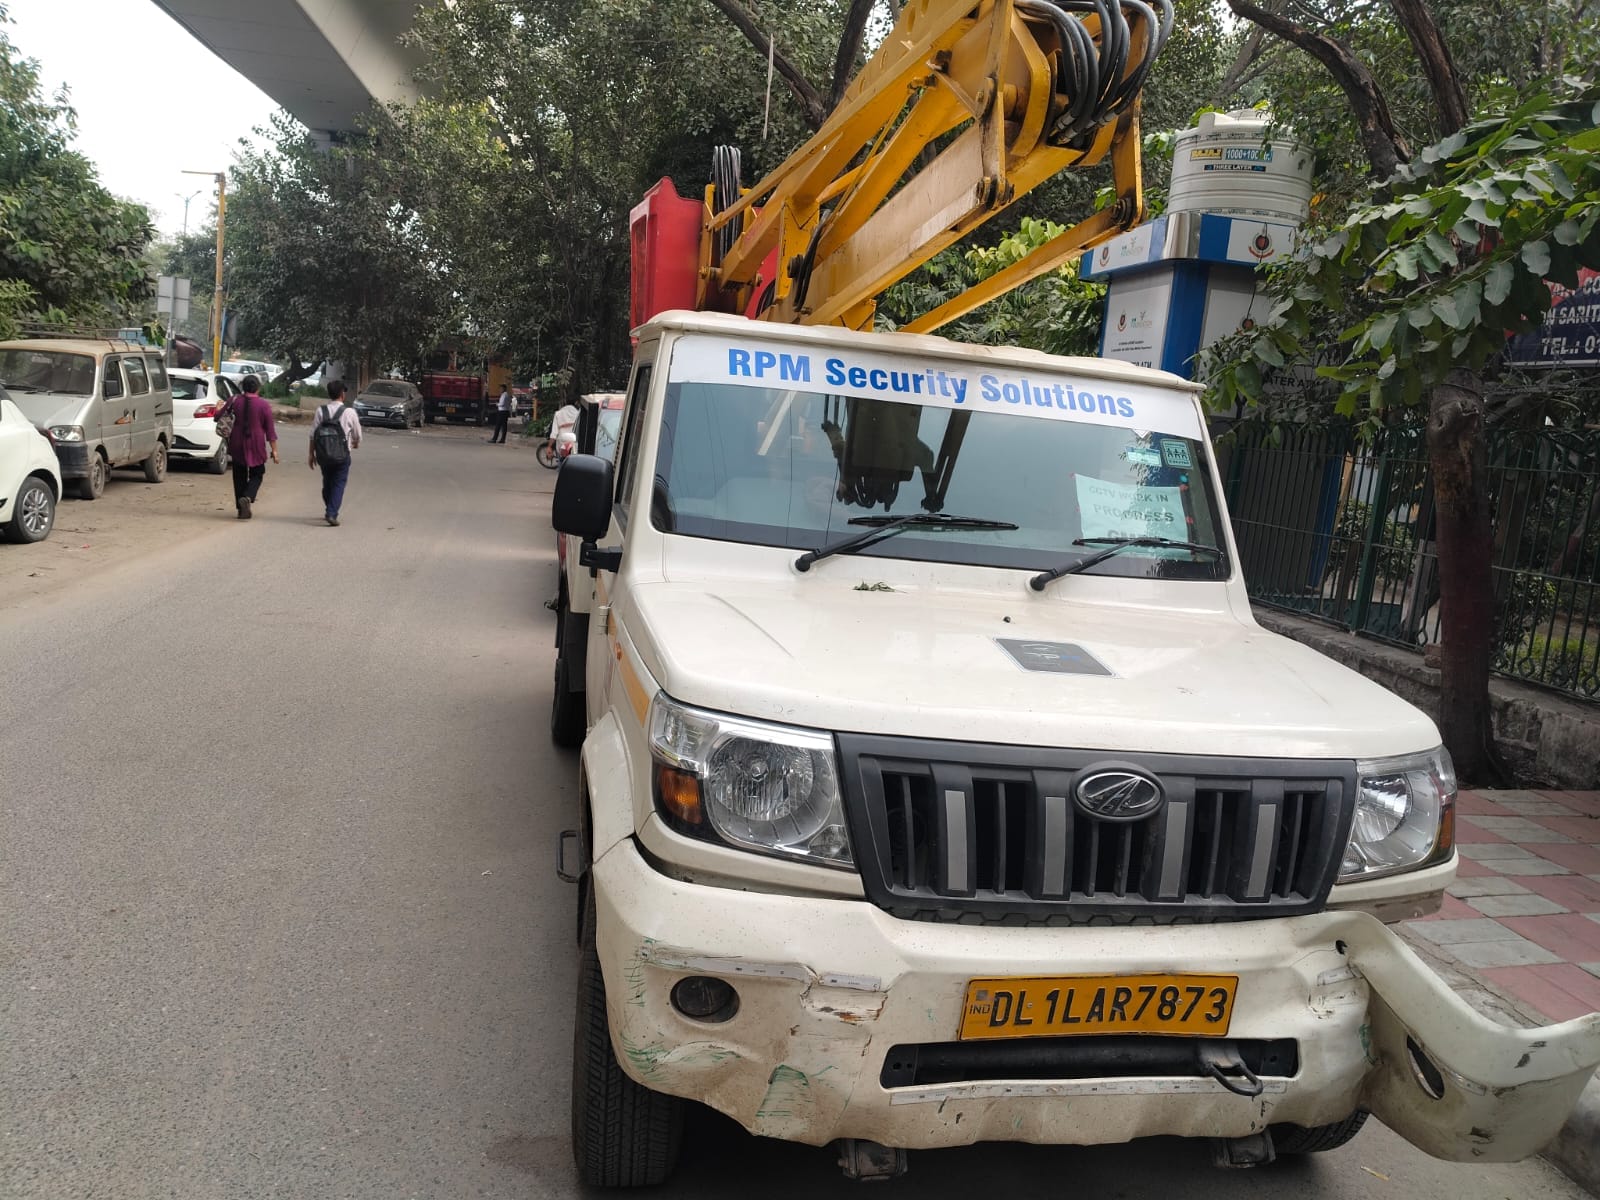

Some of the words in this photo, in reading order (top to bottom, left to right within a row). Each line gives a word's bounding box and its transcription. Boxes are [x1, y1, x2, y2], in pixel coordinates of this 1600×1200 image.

[728, 348, 811, 383] RPM
[825, 358, 968, 404] Security
[980, 374, 1135, 418] Solutions
[1088, 485, 1115, 498] CCTV
[1155, 493, 1169, 502] IN
[969, 1003, 991, 1015] IND
[989, 990, 1034, 1028] DL
[1046, 985, 1229, 1024] 1LAR7873
